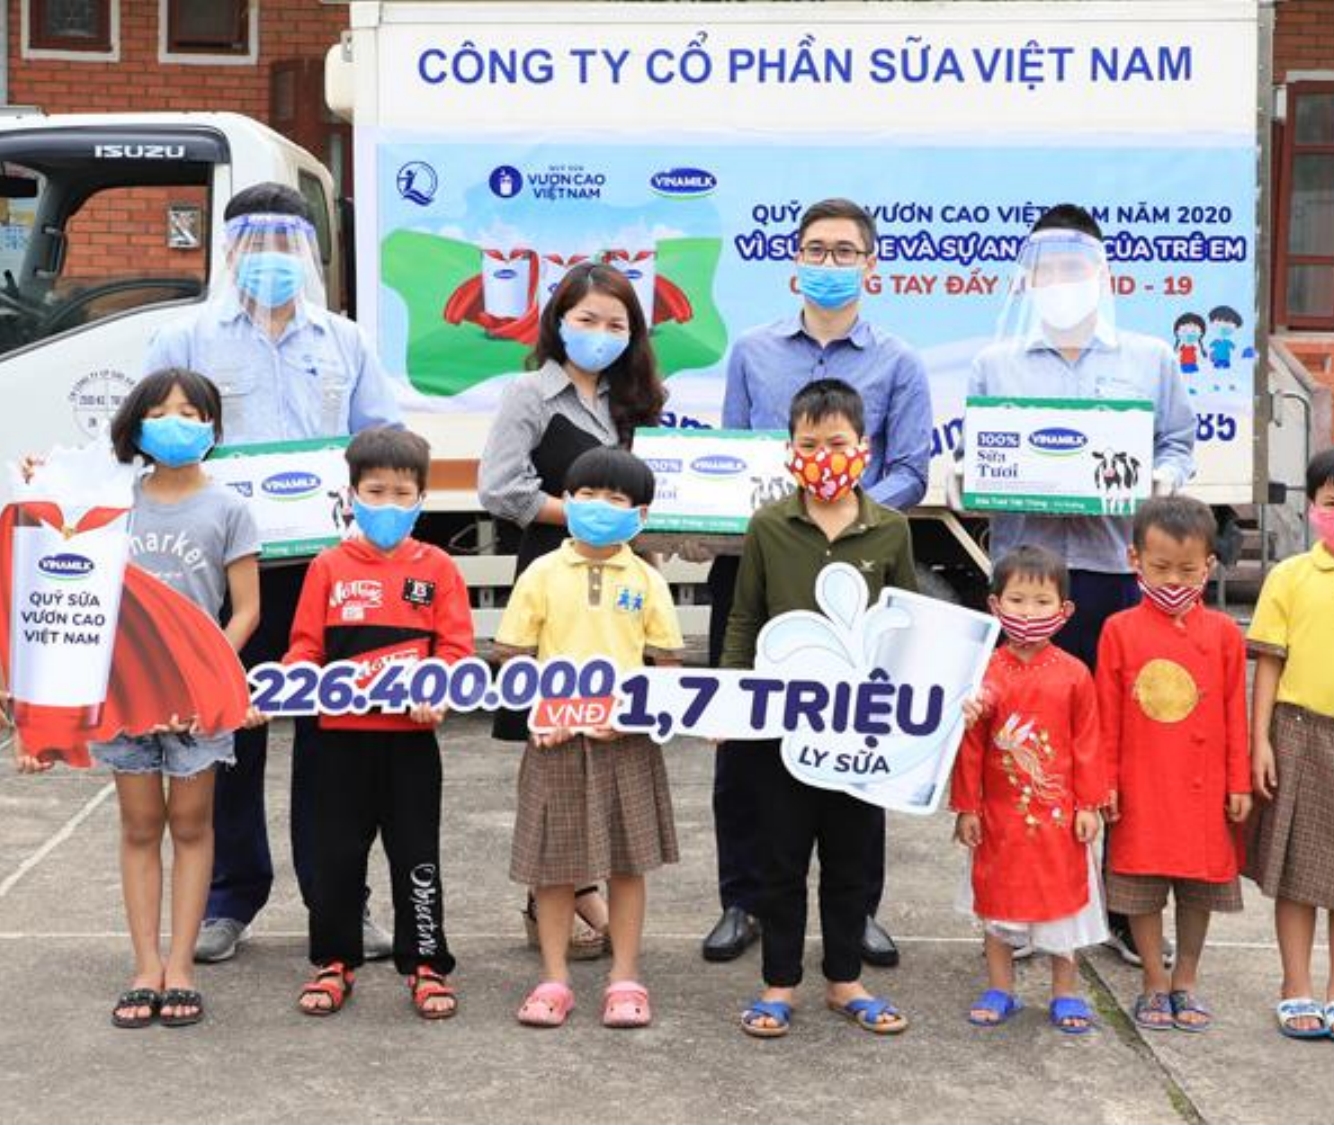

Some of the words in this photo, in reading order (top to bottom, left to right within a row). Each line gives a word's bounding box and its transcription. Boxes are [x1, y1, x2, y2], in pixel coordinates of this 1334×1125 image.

[418, 40, 555, 84] CÔNG
[569, 48, 630, 84] TY
[646, 30, 712, 84] CỔ
[728, 33, 852, 83] PHẦN
[869, 35, 964, 83] SỮA
[973, 39, 1074, 91] VIỆT
[1090, 46, 1193, 83] NAM
[94, 144, 186, 158] ISUZU
[752, 201, 802, 226] QUỸ
[941, 206, 990, 223] CAO
[1117, 202, 1170, 223] NĂM
[1178, 206, 1232, 223] 2020
[736, 231, 766, 261] VÌ
[901, 230, 938, 261] VÀ
[939, 231, 980, 266] SỰ
[1208, 235, 1246, 261] EM
[890, 275, 937, 295] TAY
[1164, 276, 1193, 295] 19
[979, 432, 1019, 447] 100%
[1031, 433, 1087, 448] VINAMILK
[41, 558, 92, 571] VINAMILK
[29, 589, 63, 607] QUỸ
[67, 590, 101, 607] SỮA
[72, 613, 105, 626] CAO
[24, 629, 59, 645] VIỆT
[63, 632, 100, 645] NAM
[252, 659, 616, 712] 226.400.000
[545, 703, 606, 725] VNĐ
[617, 674, 720, 737] 1,7
[738, 667, 945, 749] TRIỆU
[798, 745, 829, 768] LY
[833, 750, 890, 775] SỮA
